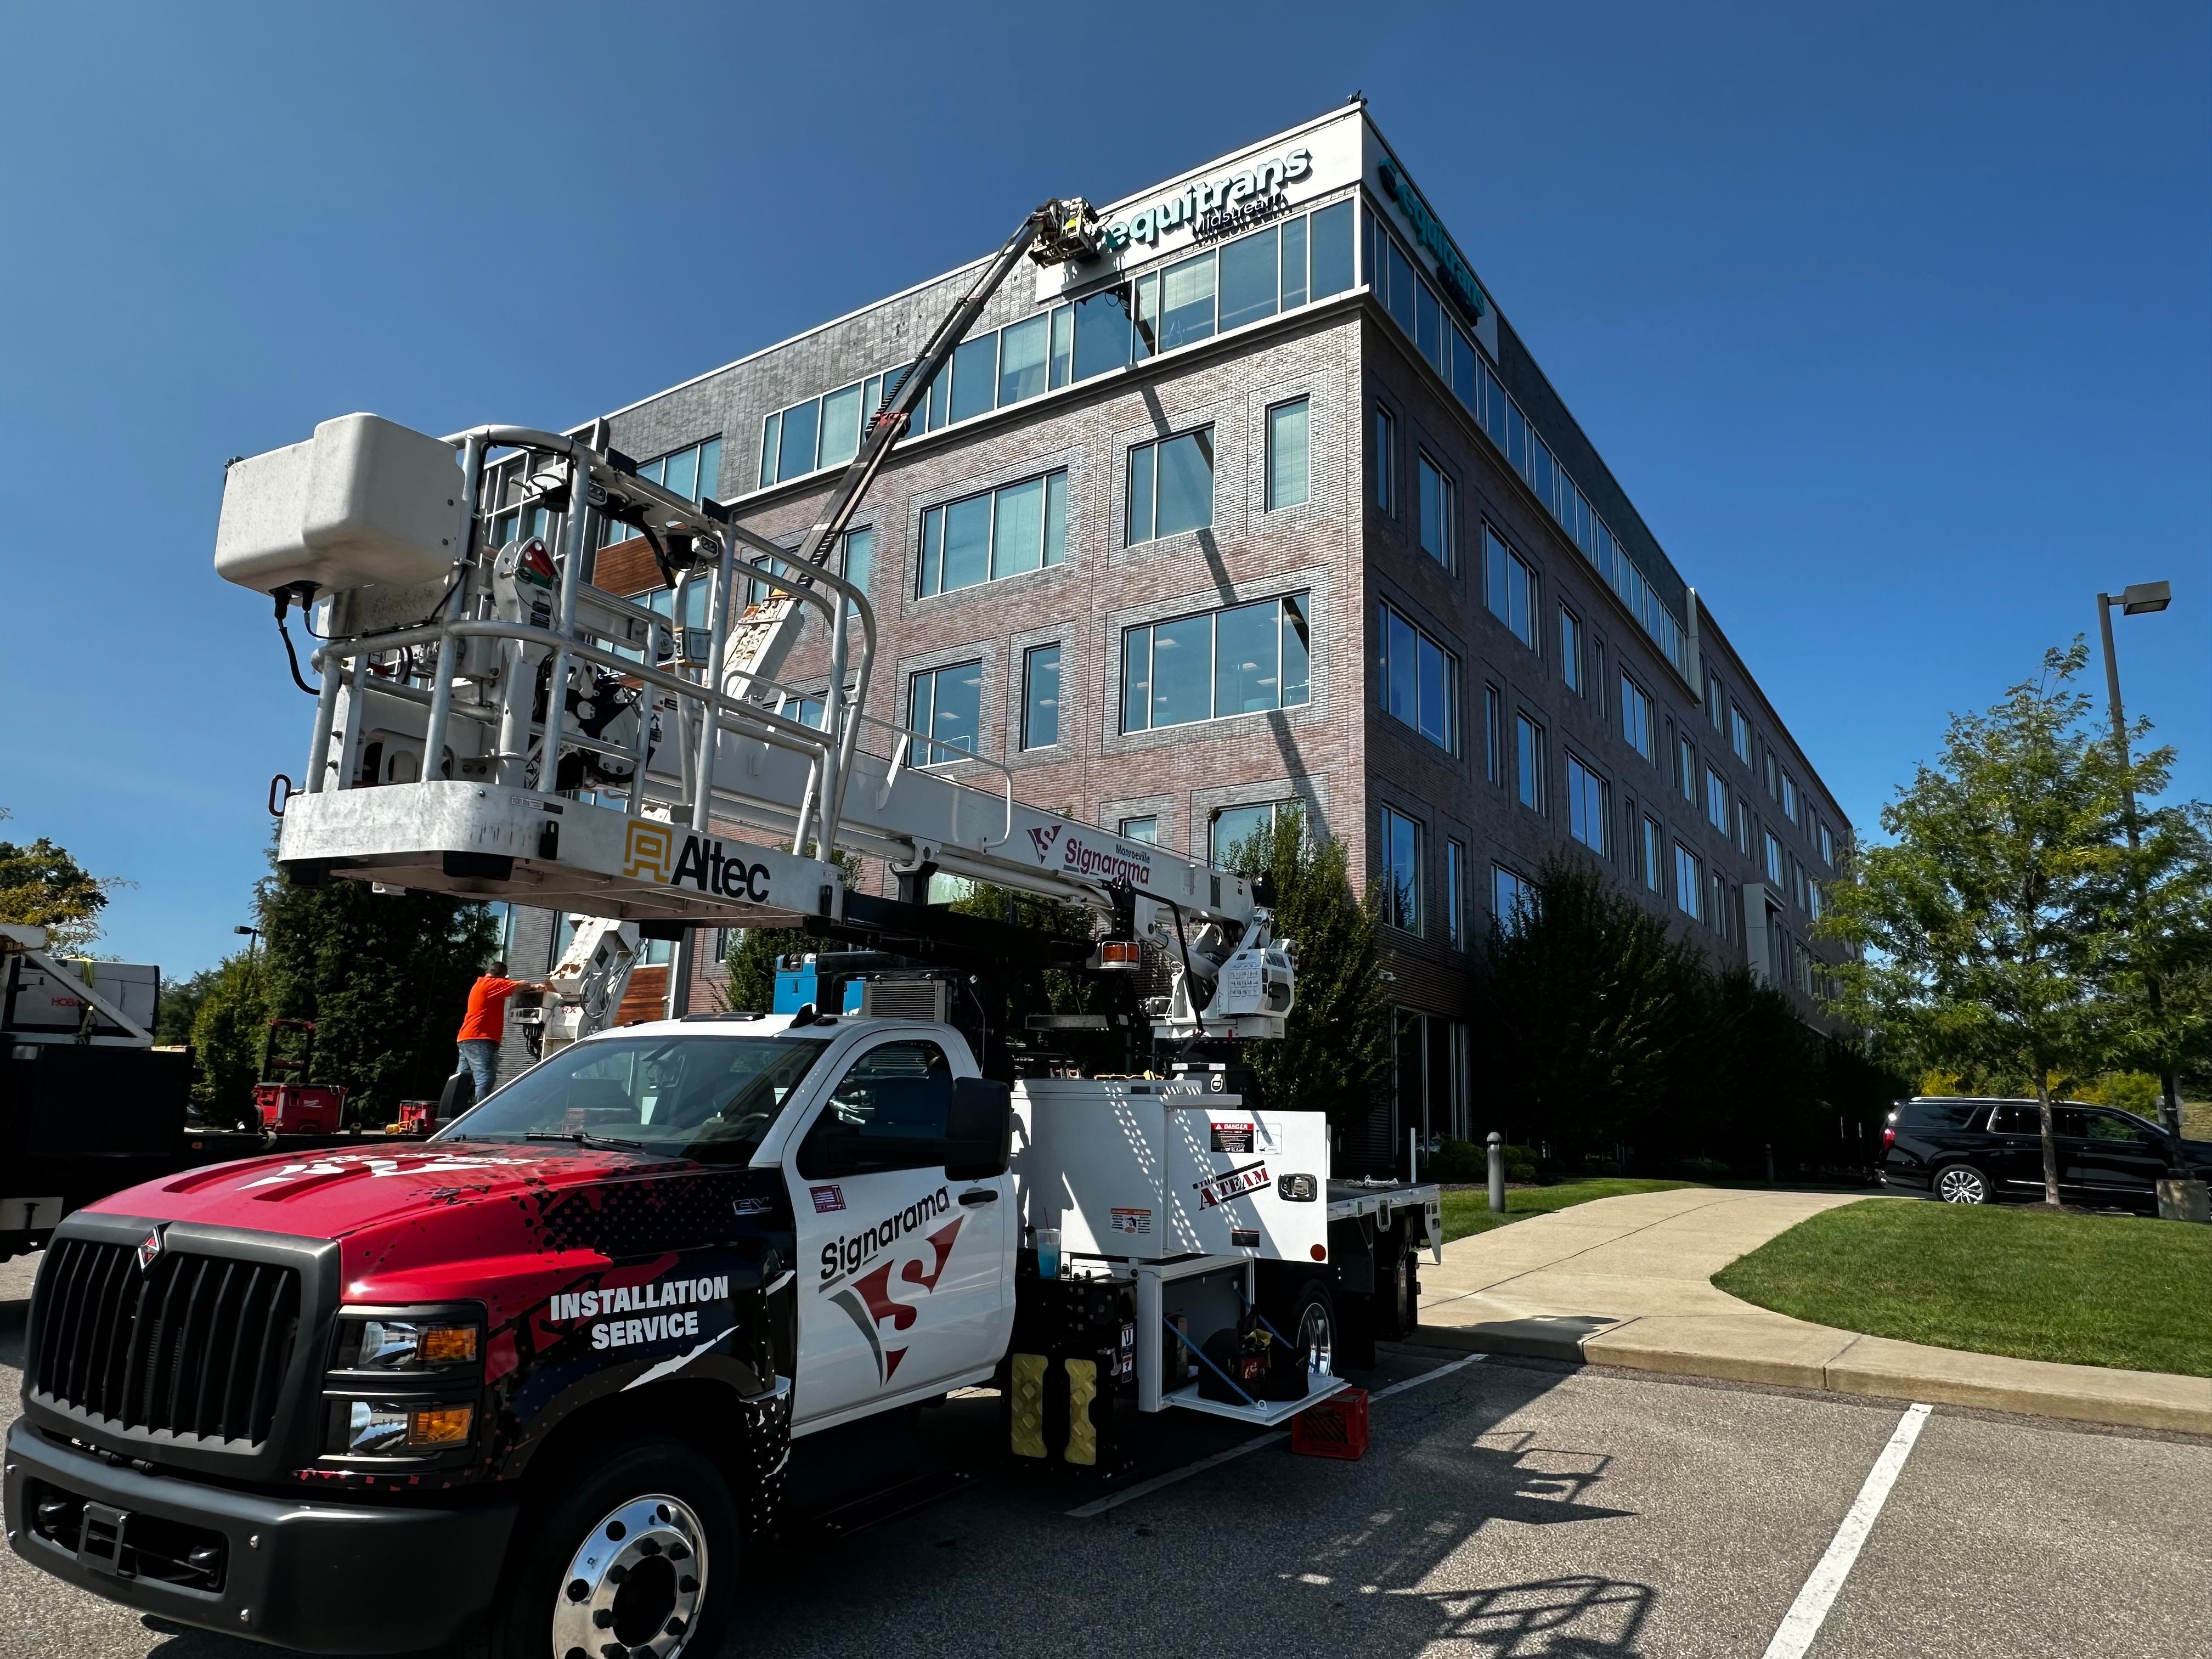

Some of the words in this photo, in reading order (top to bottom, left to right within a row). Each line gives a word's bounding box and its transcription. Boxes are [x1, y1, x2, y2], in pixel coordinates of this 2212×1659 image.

[1107, 148, 1310, 247] equitrans
[670, 834, 770, 902] Altec
[1065, 838, 1150, 884] Signarama
[1199, 1188, 1219, 1211] A
[1217, 1167, 1270, 1197] TEAM
[821, 1186, 950, 1280] Signarama
[551, 1276, 728, 1321] INSTALLATION
[591, 1311, 698, 1349] SERVICE
